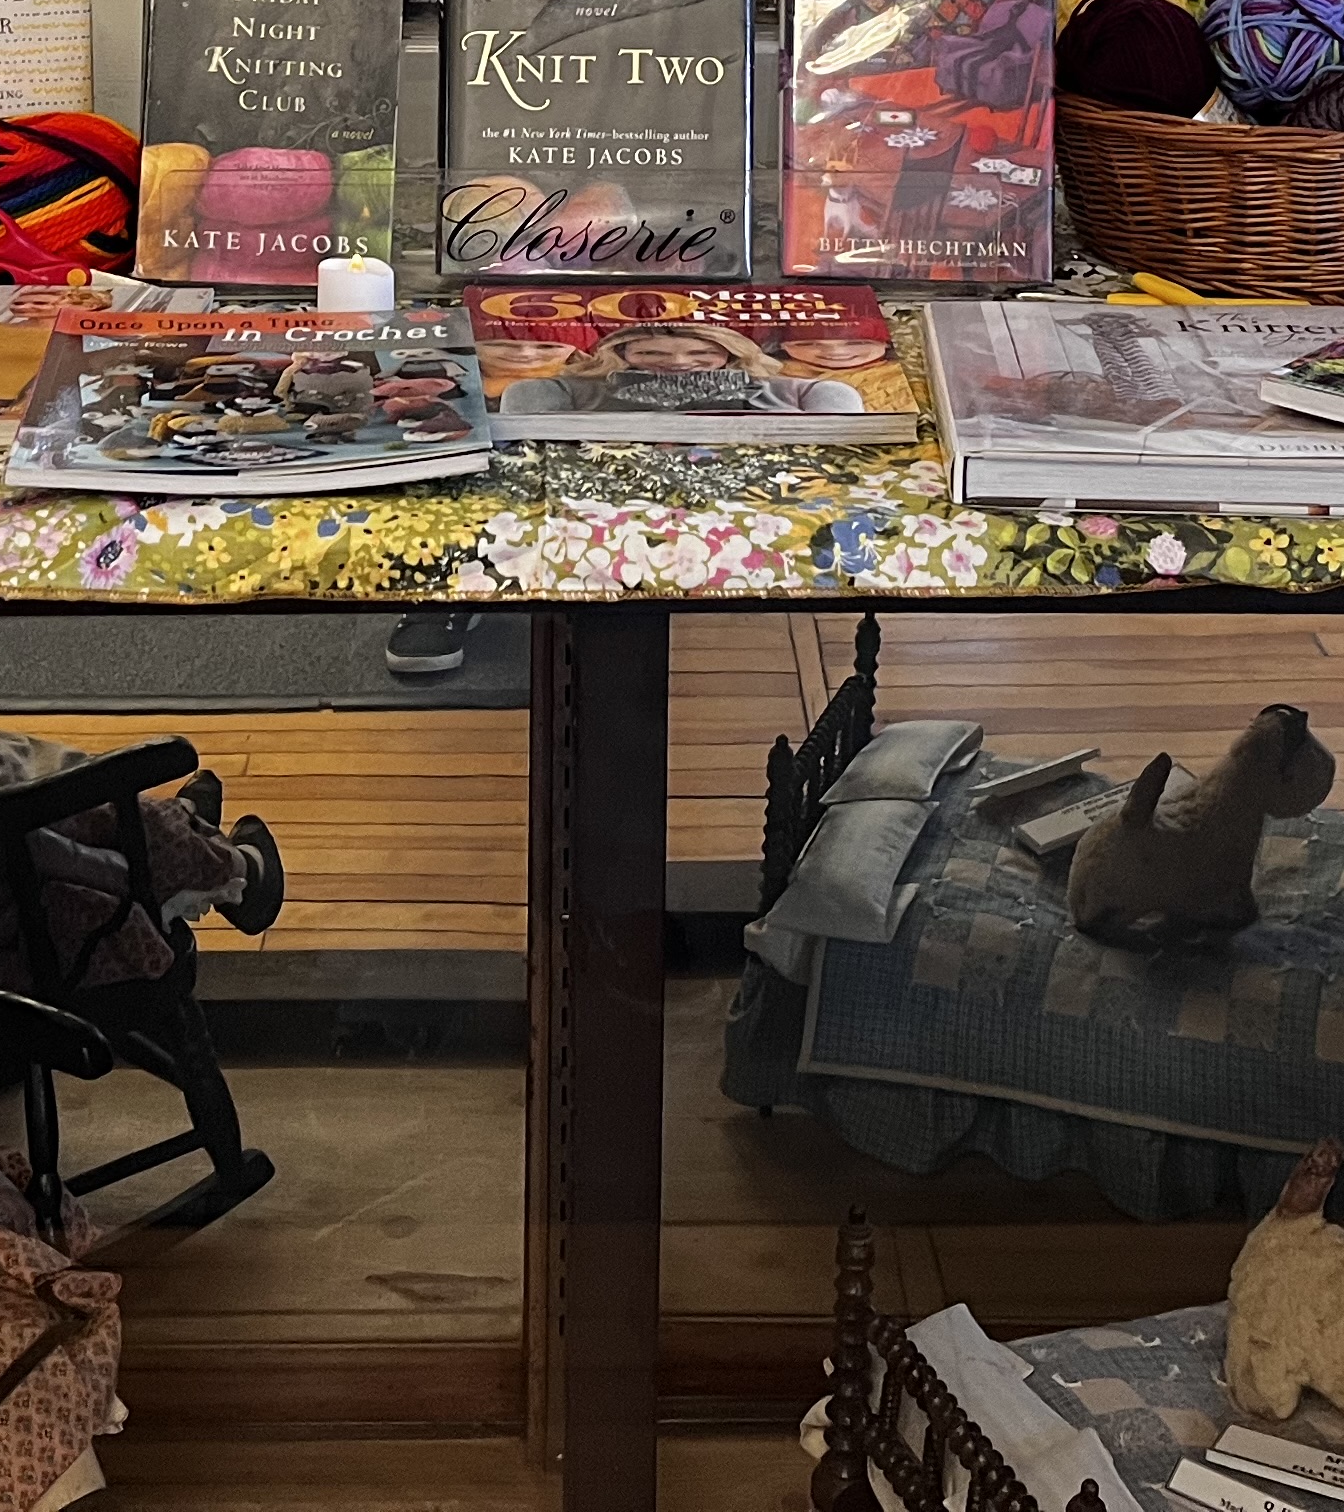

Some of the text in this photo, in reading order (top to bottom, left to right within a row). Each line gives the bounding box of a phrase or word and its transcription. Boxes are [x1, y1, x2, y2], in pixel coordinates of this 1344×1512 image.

[576, 4, 617, 18] novel
[232, 17, 321, 42] NIGHT
[205, 46, 343, 85] KNITTING
[460, 30, 725, 111] KNIT TWO
[238, 90, 307, 113] CLUB
[509, 146, 684, 168] KATE JACOBS
[162, 229, 369, 257] KATE JACOBS
[820, 238, 1027, 257] BETTY HECHTMAN
[480, 291, 700, 321] 60
[688, 289, 824, 303] More
[690, 299, 847, 312] Quick
[80, 319, 144, 330] Once
[156, 319, 225, 331] Upon
[268, 317, 335, 328] Time
[693, 310, 842, 321] Knits
[222, 325, 449, 342] In Crochet
